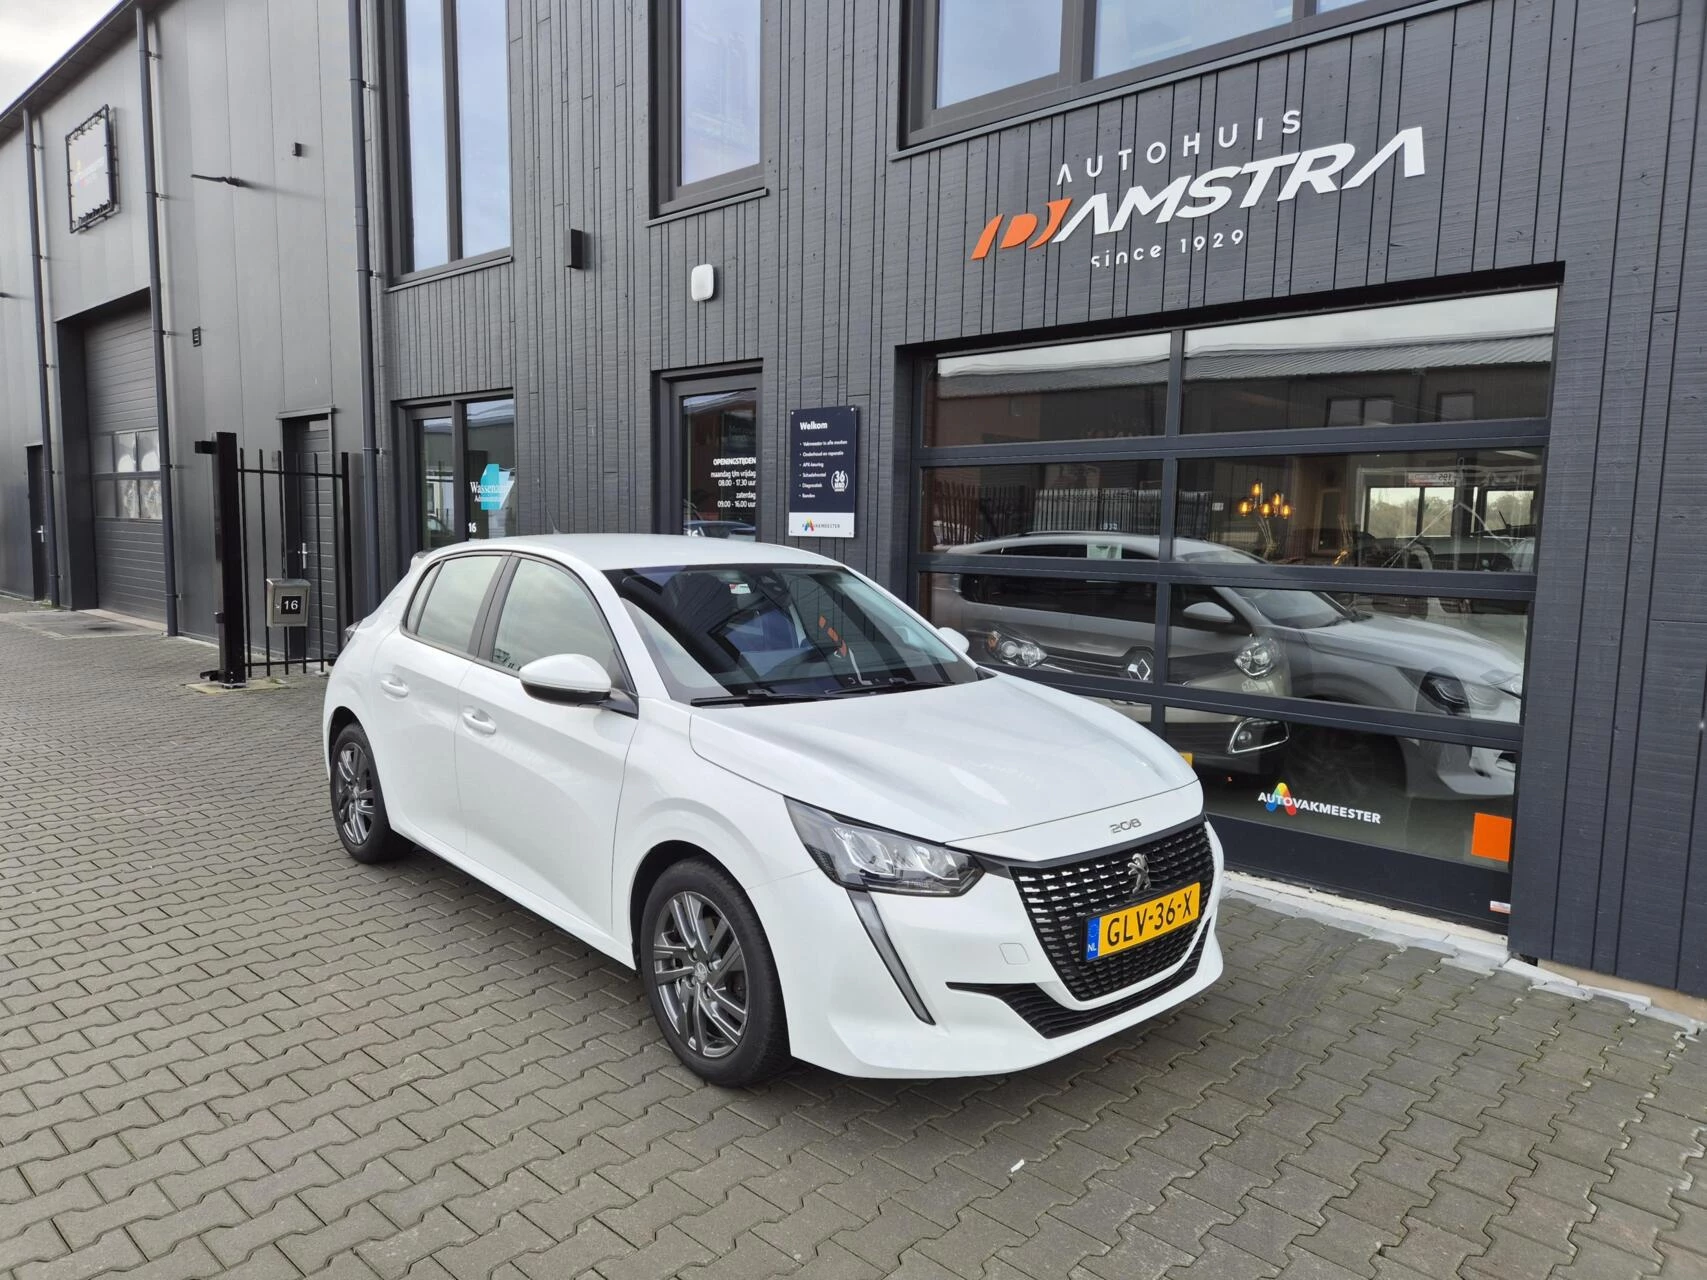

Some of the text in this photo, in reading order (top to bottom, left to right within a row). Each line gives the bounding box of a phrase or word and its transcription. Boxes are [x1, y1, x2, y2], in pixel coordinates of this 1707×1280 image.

[1055, 109, 1302, 186] AUTOHUIS
[1090, 229, 1245, 269] since 1929
[800, 421, 828, 430] Welkom
[713, 457, 756, 466] OPENINGSTIJDEN
[710, 470, 731, 479] maandag
[740, 470, 756, 479] vrijdag
[834, 470, 845, 482] 36
[470, 481, 509, 494] Wassena
[736, 491, 756, 500] zaterdag
[468, 522, 477, 533] 16
[284, 599, 298, 610] 16
[1257, 791, 1382, 825] AUTOVAKMEESTER
[1110, 818, 1142, 834] 208
[1106, 889, 1193, 947] GLV-36-X
[1086, 943, 1097, 954] NL
